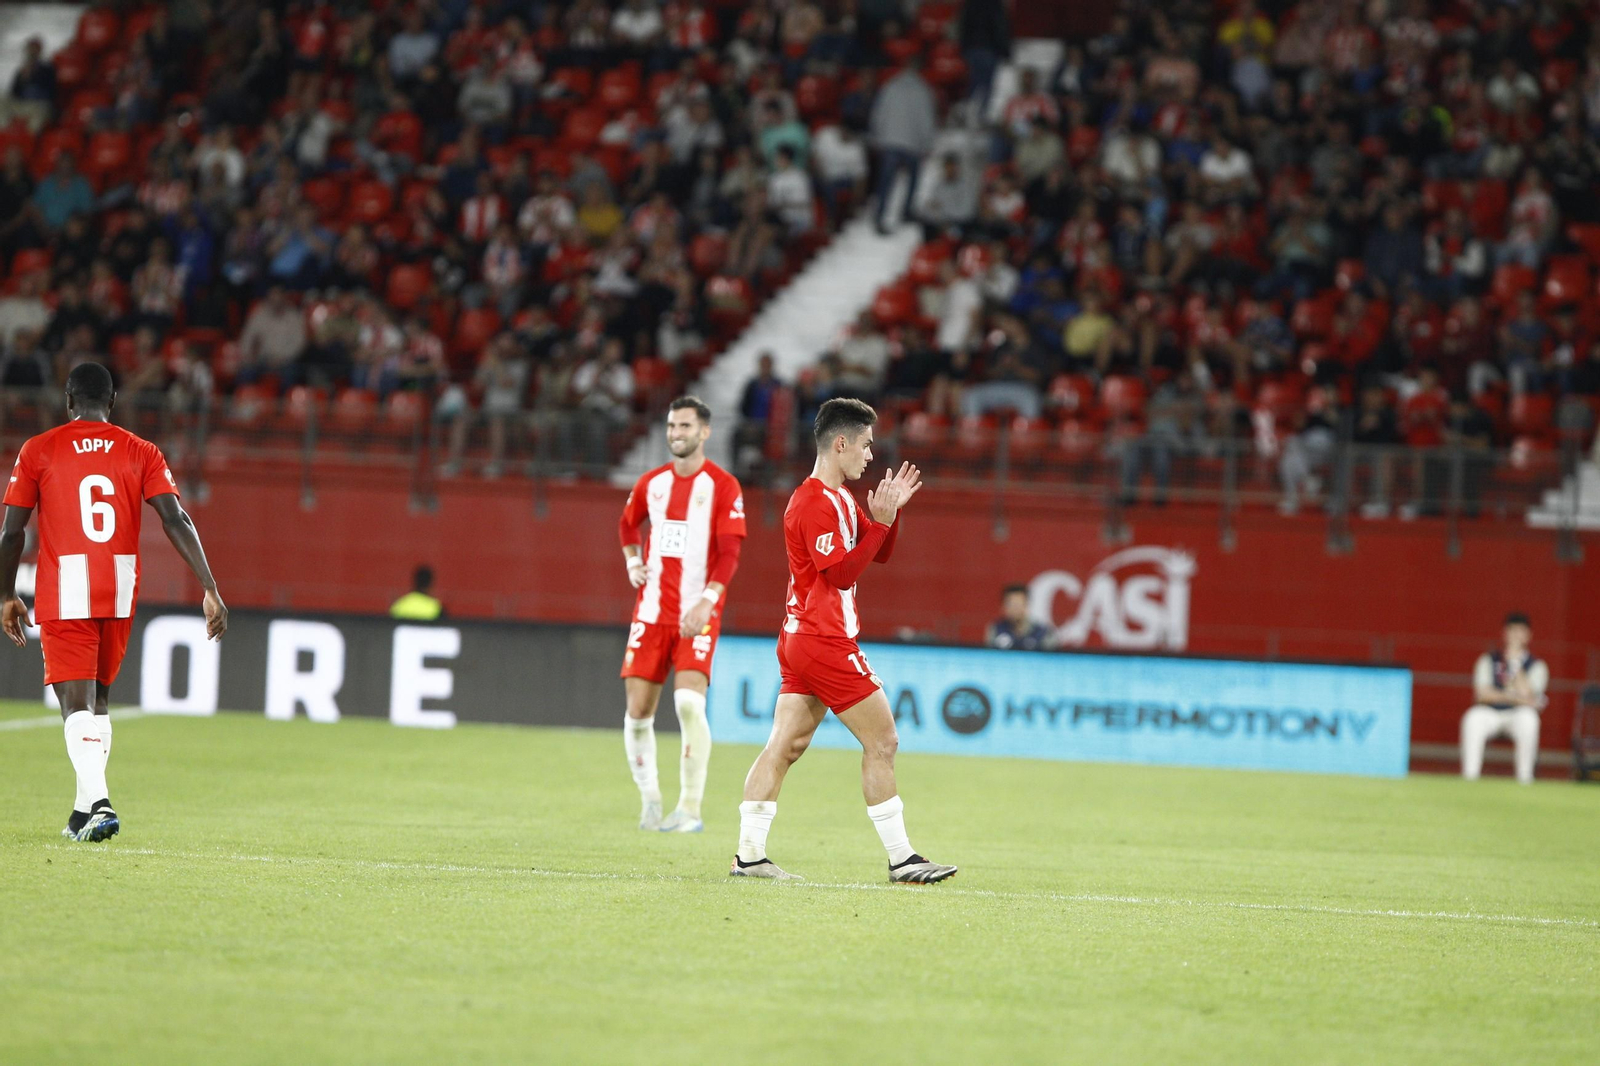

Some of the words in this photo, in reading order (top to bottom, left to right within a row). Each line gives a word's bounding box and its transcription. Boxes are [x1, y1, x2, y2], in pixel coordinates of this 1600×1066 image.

[72, 438, 114, 454] LOPY
[79, 474, 116, 543] 6
[1029, 550, 1193, 651] CASI
[27, 608, 462, 728] ORE
